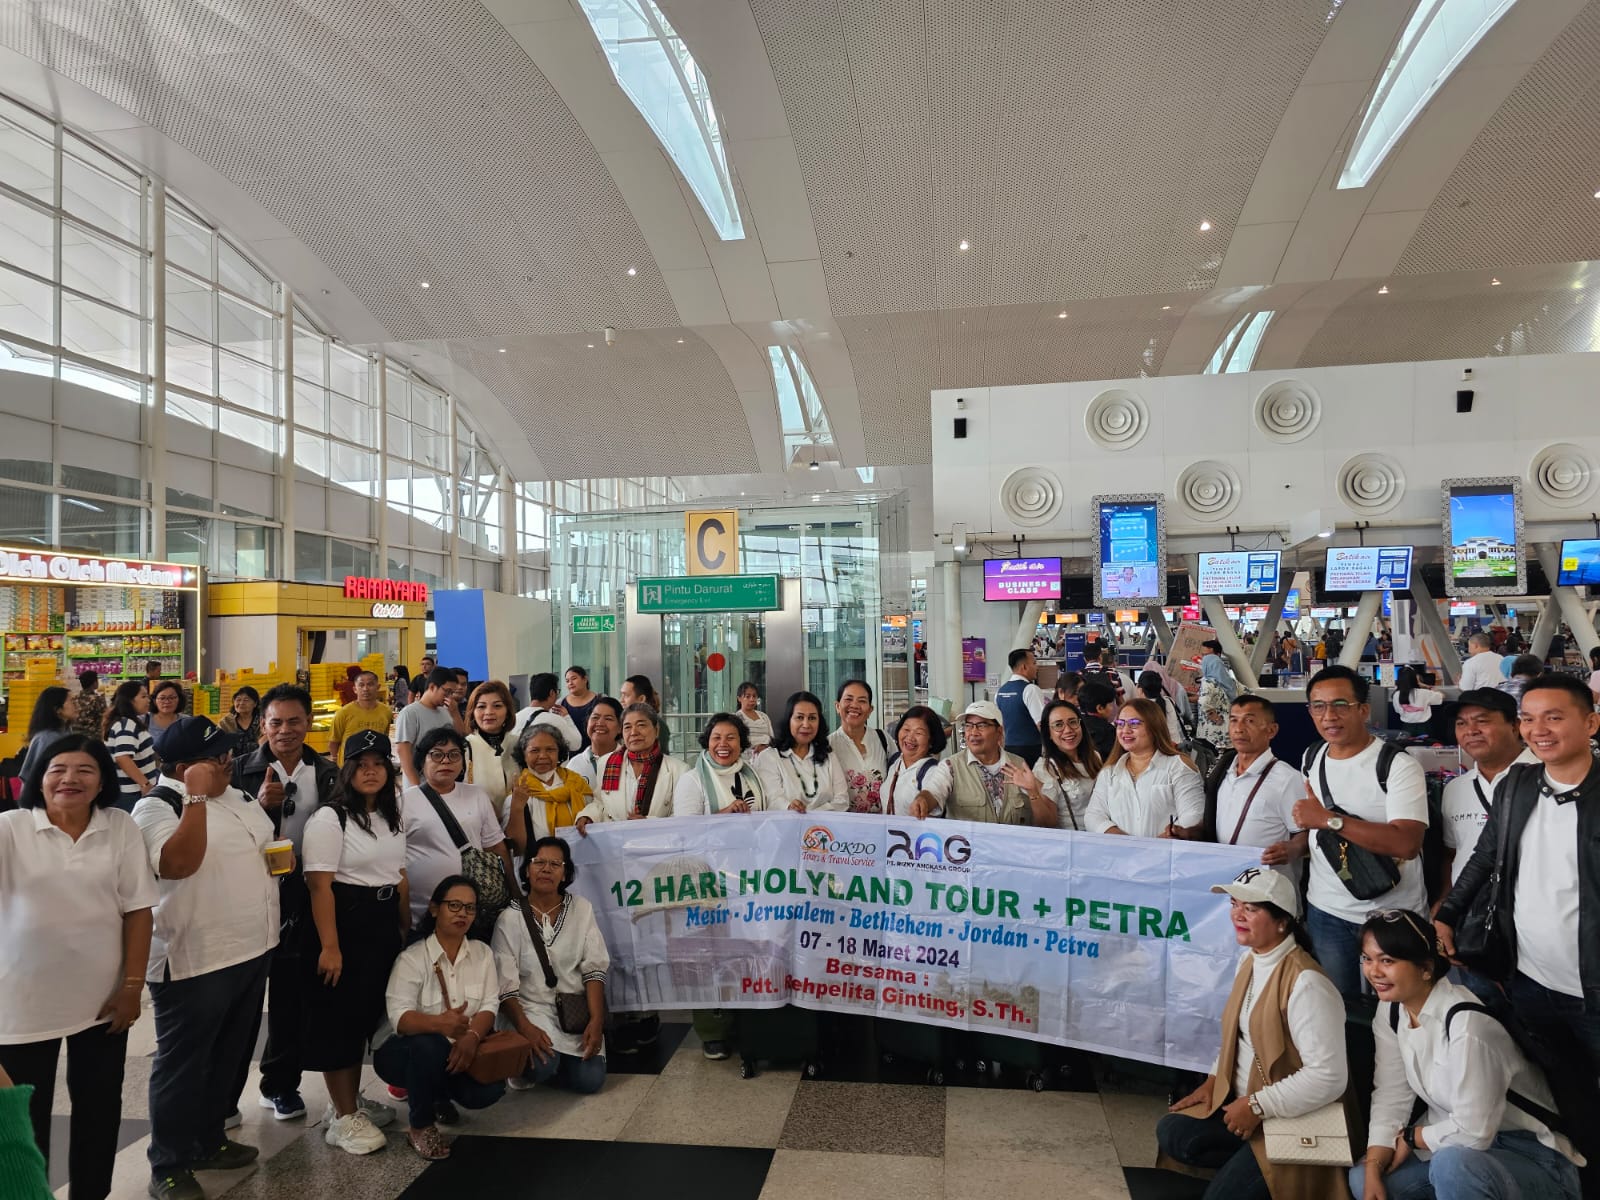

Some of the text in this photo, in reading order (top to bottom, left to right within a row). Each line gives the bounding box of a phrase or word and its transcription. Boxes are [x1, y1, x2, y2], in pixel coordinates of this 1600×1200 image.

[697, 518, 727, 570] C
[50, 556, 105, 582] Oleh
[106, 562, 175, 586] Medan
[344, 575, 429, 602] RAMAYANA
[664, 584, 691, 595] Pintu
[694, 584, 733, 594] Darurat
[828, 854, 850, 865] Travel
[851, 856, 876, 867] Service
[948, 865, 971, 873] GROUP
[611, 867, 1191, 942] 12 HARI HOLYLAND TOUR + PETRA
[686, 904, 730, 928] Mesir
[743, 901, 835, 925] Jerusalem
[849, 908, 943, 938] Bethlehem
[958, 920, 1028, 948] Jordan
[1045, 930, 1099, 958] Petra
[800, 931, 821, 950] 07
[838, 935, 857, 955] 18
[862, 938, 911, 962] Maret
[916, 945, 960, 968] 2024
[826, 957, 916, 984] Bersama
[742, 974, 1032, 1024] Pdt. Rehpelita Ginting, S.Th.
